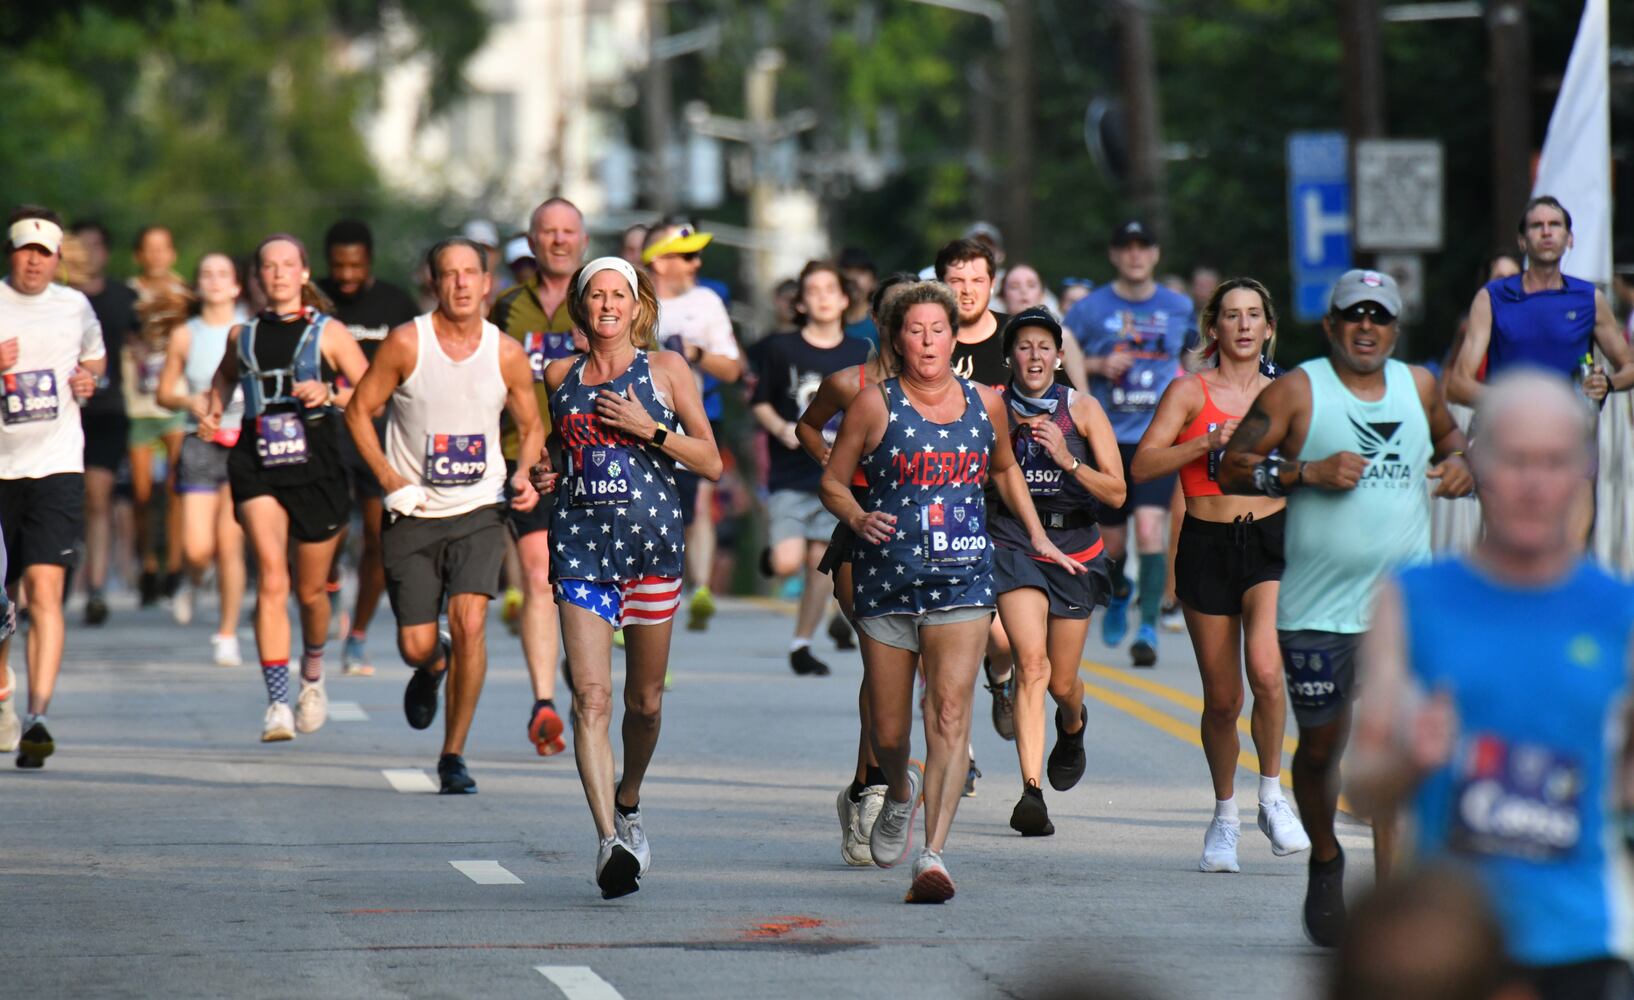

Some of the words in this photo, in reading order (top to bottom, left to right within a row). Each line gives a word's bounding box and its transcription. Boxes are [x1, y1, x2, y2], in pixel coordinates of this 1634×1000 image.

[529, 352, 543, 370] C
[8, 395, 23, 413] B
[257, 439, 268, 456] C
[435, 456, 449, 475] C
[451, 461, 486, 475] 9479
[1025, 469, 1063, 483] 5507
[574, 476, 587, 497] A
[591, 479, 628, 495] 1863
[933, 531, 949, 552] B
[951, 535, 987, 551] 6020
